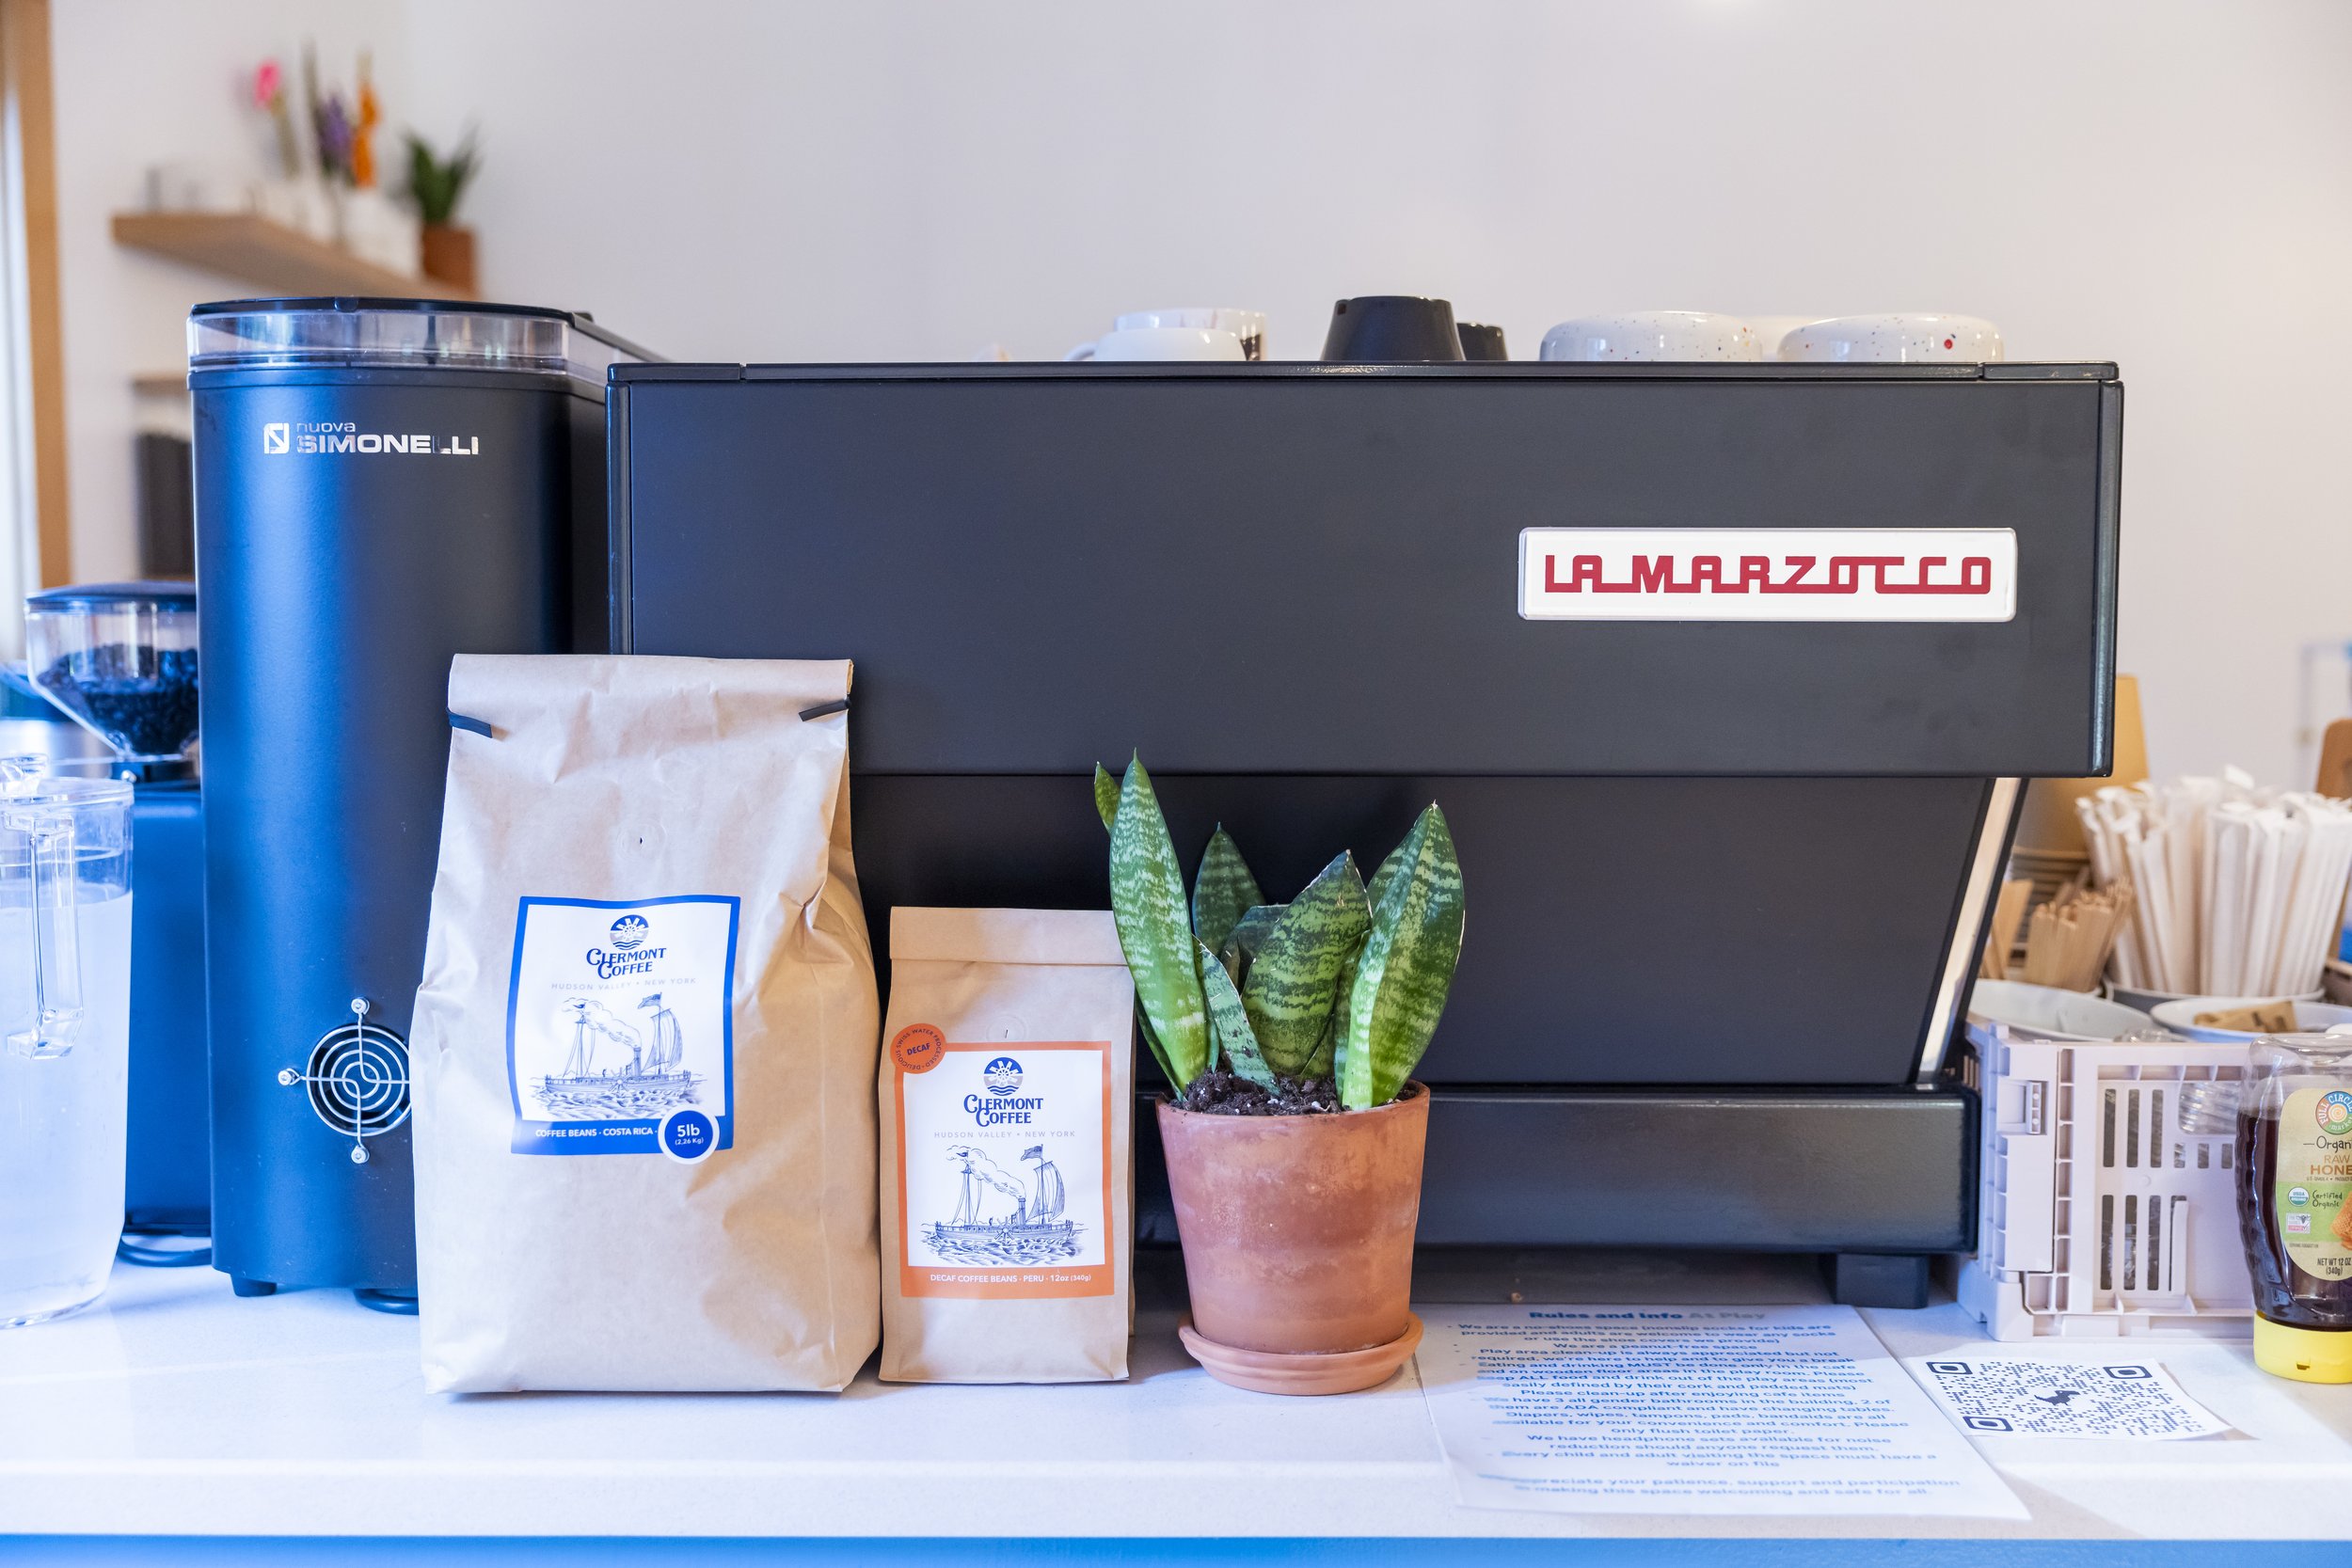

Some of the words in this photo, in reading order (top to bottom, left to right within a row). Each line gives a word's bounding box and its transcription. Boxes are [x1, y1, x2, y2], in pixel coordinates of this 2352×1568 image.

[296, 421, 356, 433] nuova
[296, 434, 479, 455] SIMONELLI
[1545, 555, 1603, 594] LA
[1632, 555, 1992, 594] MARZOCCO
[586, 947, 667, 966] CLERMONT
[597, 961, 653, 980] COFFEE
[551, 982, 594, 990] HUDSON
[598, 981, 632, 990] VALLEY
[644, 978, 665, 987] NEW
[906, 1042, 930, 1055] DECAF
[963, 1094, 1043, 1113] CLERMONT
[976, 1108, 1031, 1127] COFFEE
[2318, 1102, 2329, 1125] FULL
[535, 1129, 567, 1137] COFFEE
[568, 1129, 597, 1137] BEANS
[603, 1128, 632, 1136] COSTA
[633, 1127, 654, 1135] RICA
[677, 1124, 700, 1137] 5lb
[2316, 1135, 2352, 1153] Organ
[2325, 1155, 2350, 1164] RAW
[2310, 1164, 2352, 1176] HONE
[2312, 1189, 2342, 1199] Certified
[2312, 1199, 2339, 1209] Organic
[958, 1275, 989, 1283] COFFEE
[991, 1275, 1017, 1283] BEANS
[1024, 1275, 1044, 1283] PERU
[1071, 1274, 1091, 1282] (340g)
